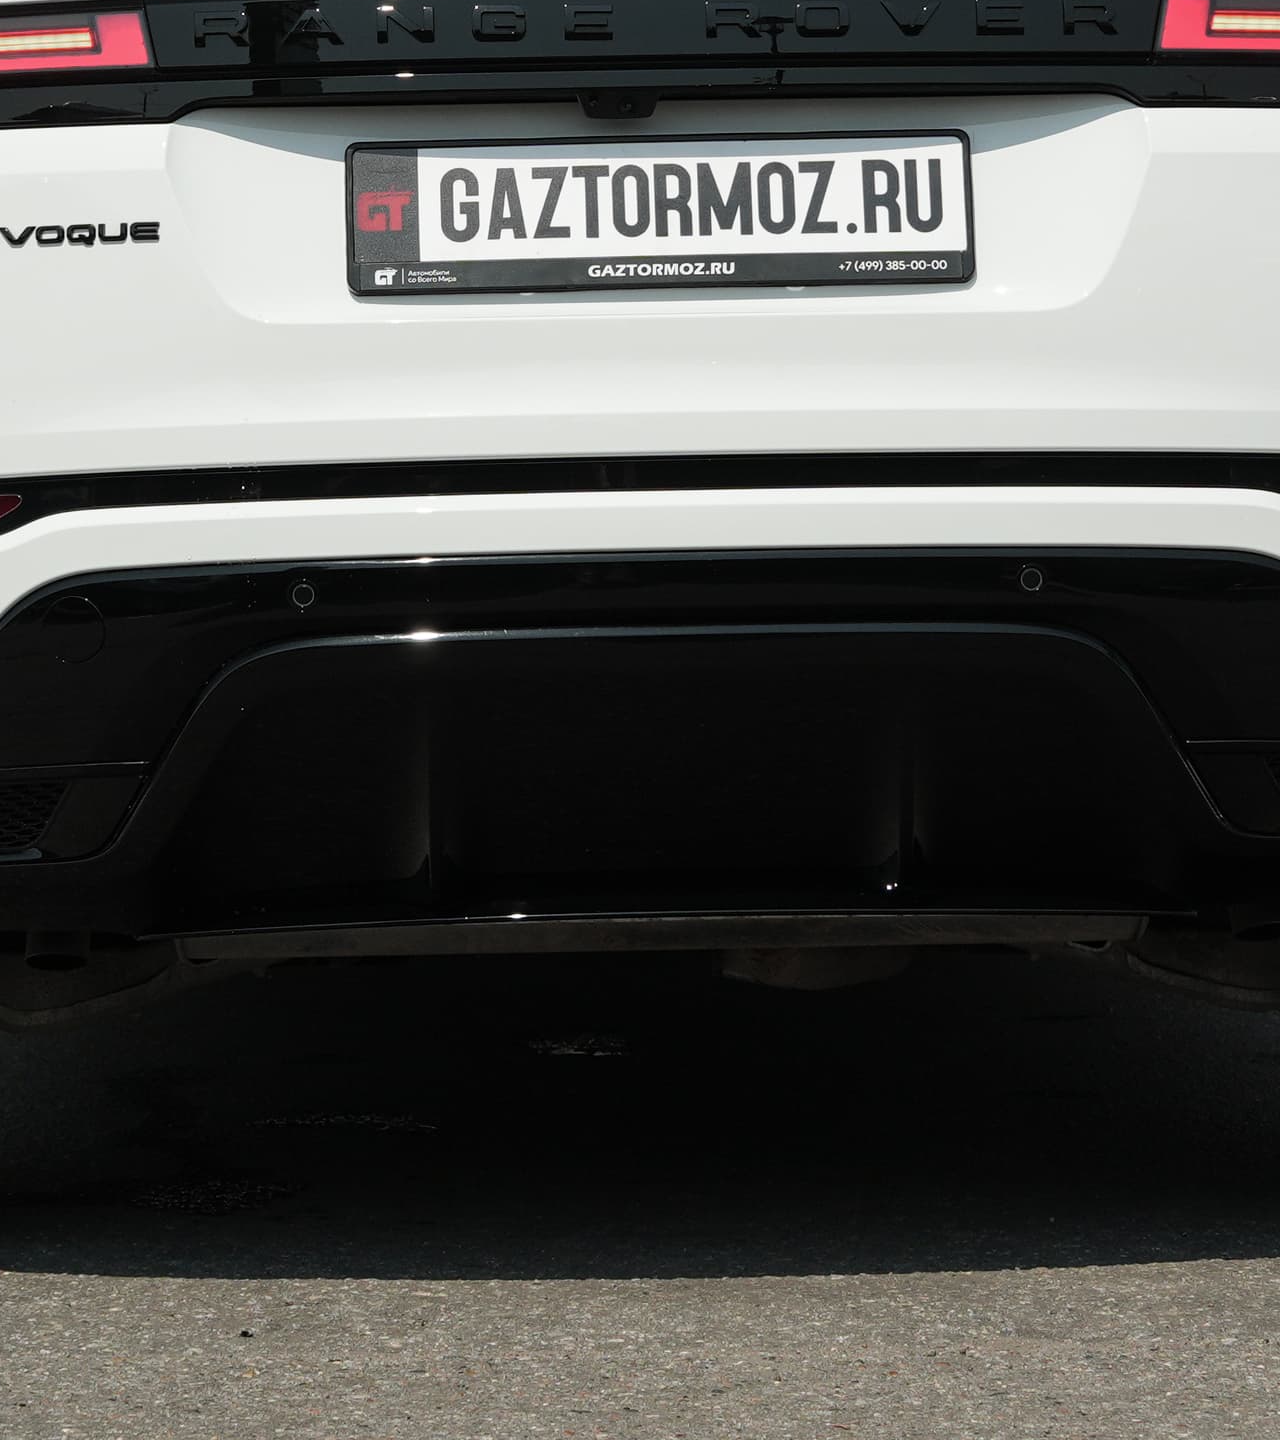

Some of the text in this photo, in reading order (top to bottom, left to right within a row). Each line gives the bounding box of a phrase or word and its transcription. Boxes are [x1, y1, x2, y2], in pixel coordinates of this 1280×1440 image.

[193, 3, 614, 48] RANGE
[439, 158, 944, 243] GAZTORMOZ.RU
[587, 262, 736, 278] GAZTORMOZ.RU
[838, 260, 948, 272] +7 (499) 385-00-00
